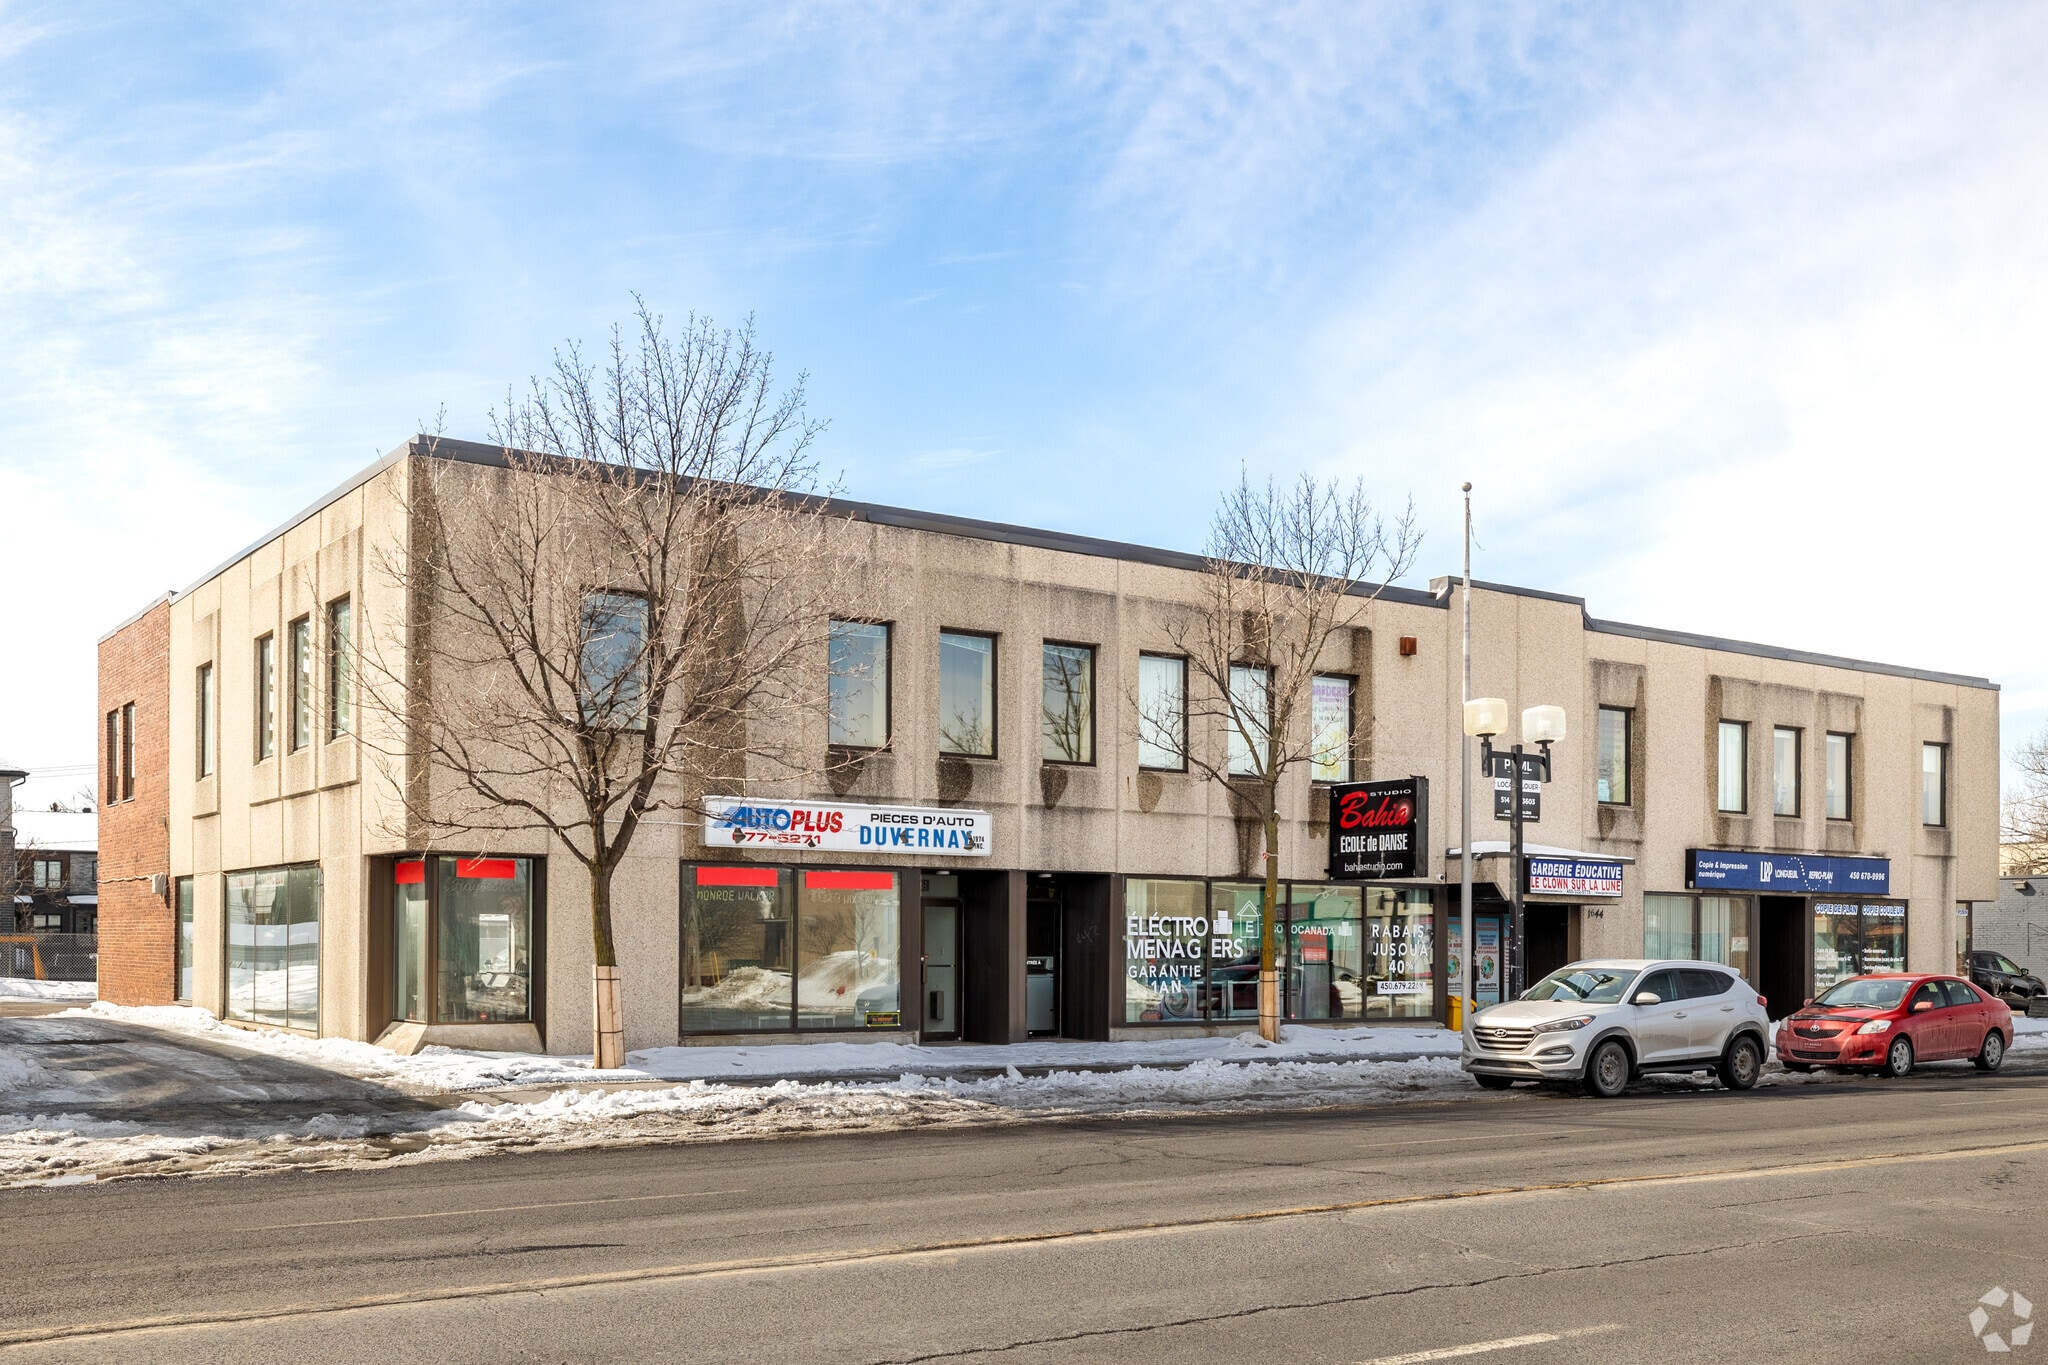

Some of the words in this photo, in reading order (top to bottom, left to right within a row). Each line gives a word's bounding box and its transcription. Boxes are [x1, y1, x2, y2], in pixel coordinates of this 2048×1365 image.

[1504, 758, 1532, 772] PML
[1370, 789, 1411, 797] STUDIO
[1340, 791, 1409, 829] Bahia
[870, 813, 919, 824] PIECES
[923, 816, 975, 827] D'AUTO
[732, 832, 821, 845] 77-5271
[860, 825, 973, 849] DUVERNAY
[1340, 835, 1366, 853] ÉCOLE
[1367, 835, 1378, 852] de
[1379, 833, 1408, 851] DANSE
[1344, 862, 1403, 872] bahiastudio.com
[1531, 862, 1573, 877] GARDERIE
[1574, 863, 1622, 879] ÉDUCATIVE
[1698, 860, 1714, 870] Copie
[1714, 861, 1719, 869] &
[1849, 871, 1860, 880] 450
[1531, 876, 1540, 888] LE
[1542, 877, 1569, 890] CLOWN
[1571, 878, 1587, 891] SUR
[1589, 879, 1599, 891] LA
[1601, 880, 1621, 892] LUNE
[696, 890, 735, 901] MONROE
[1587, 909, 1604, 919] 1644
[1815, 902, 1833, 914] COPIE
[1833, 903, 1842, 915] DE
[1842, 904, 1858, 916] PLAN
[1862, 904, 1879, 916] COPIE
[1879, 905, 1905, 917] COULEUR
[1372, 924, 1425, 938] RABAIS
[1128, 964, 1201, 978] GARANTIE
